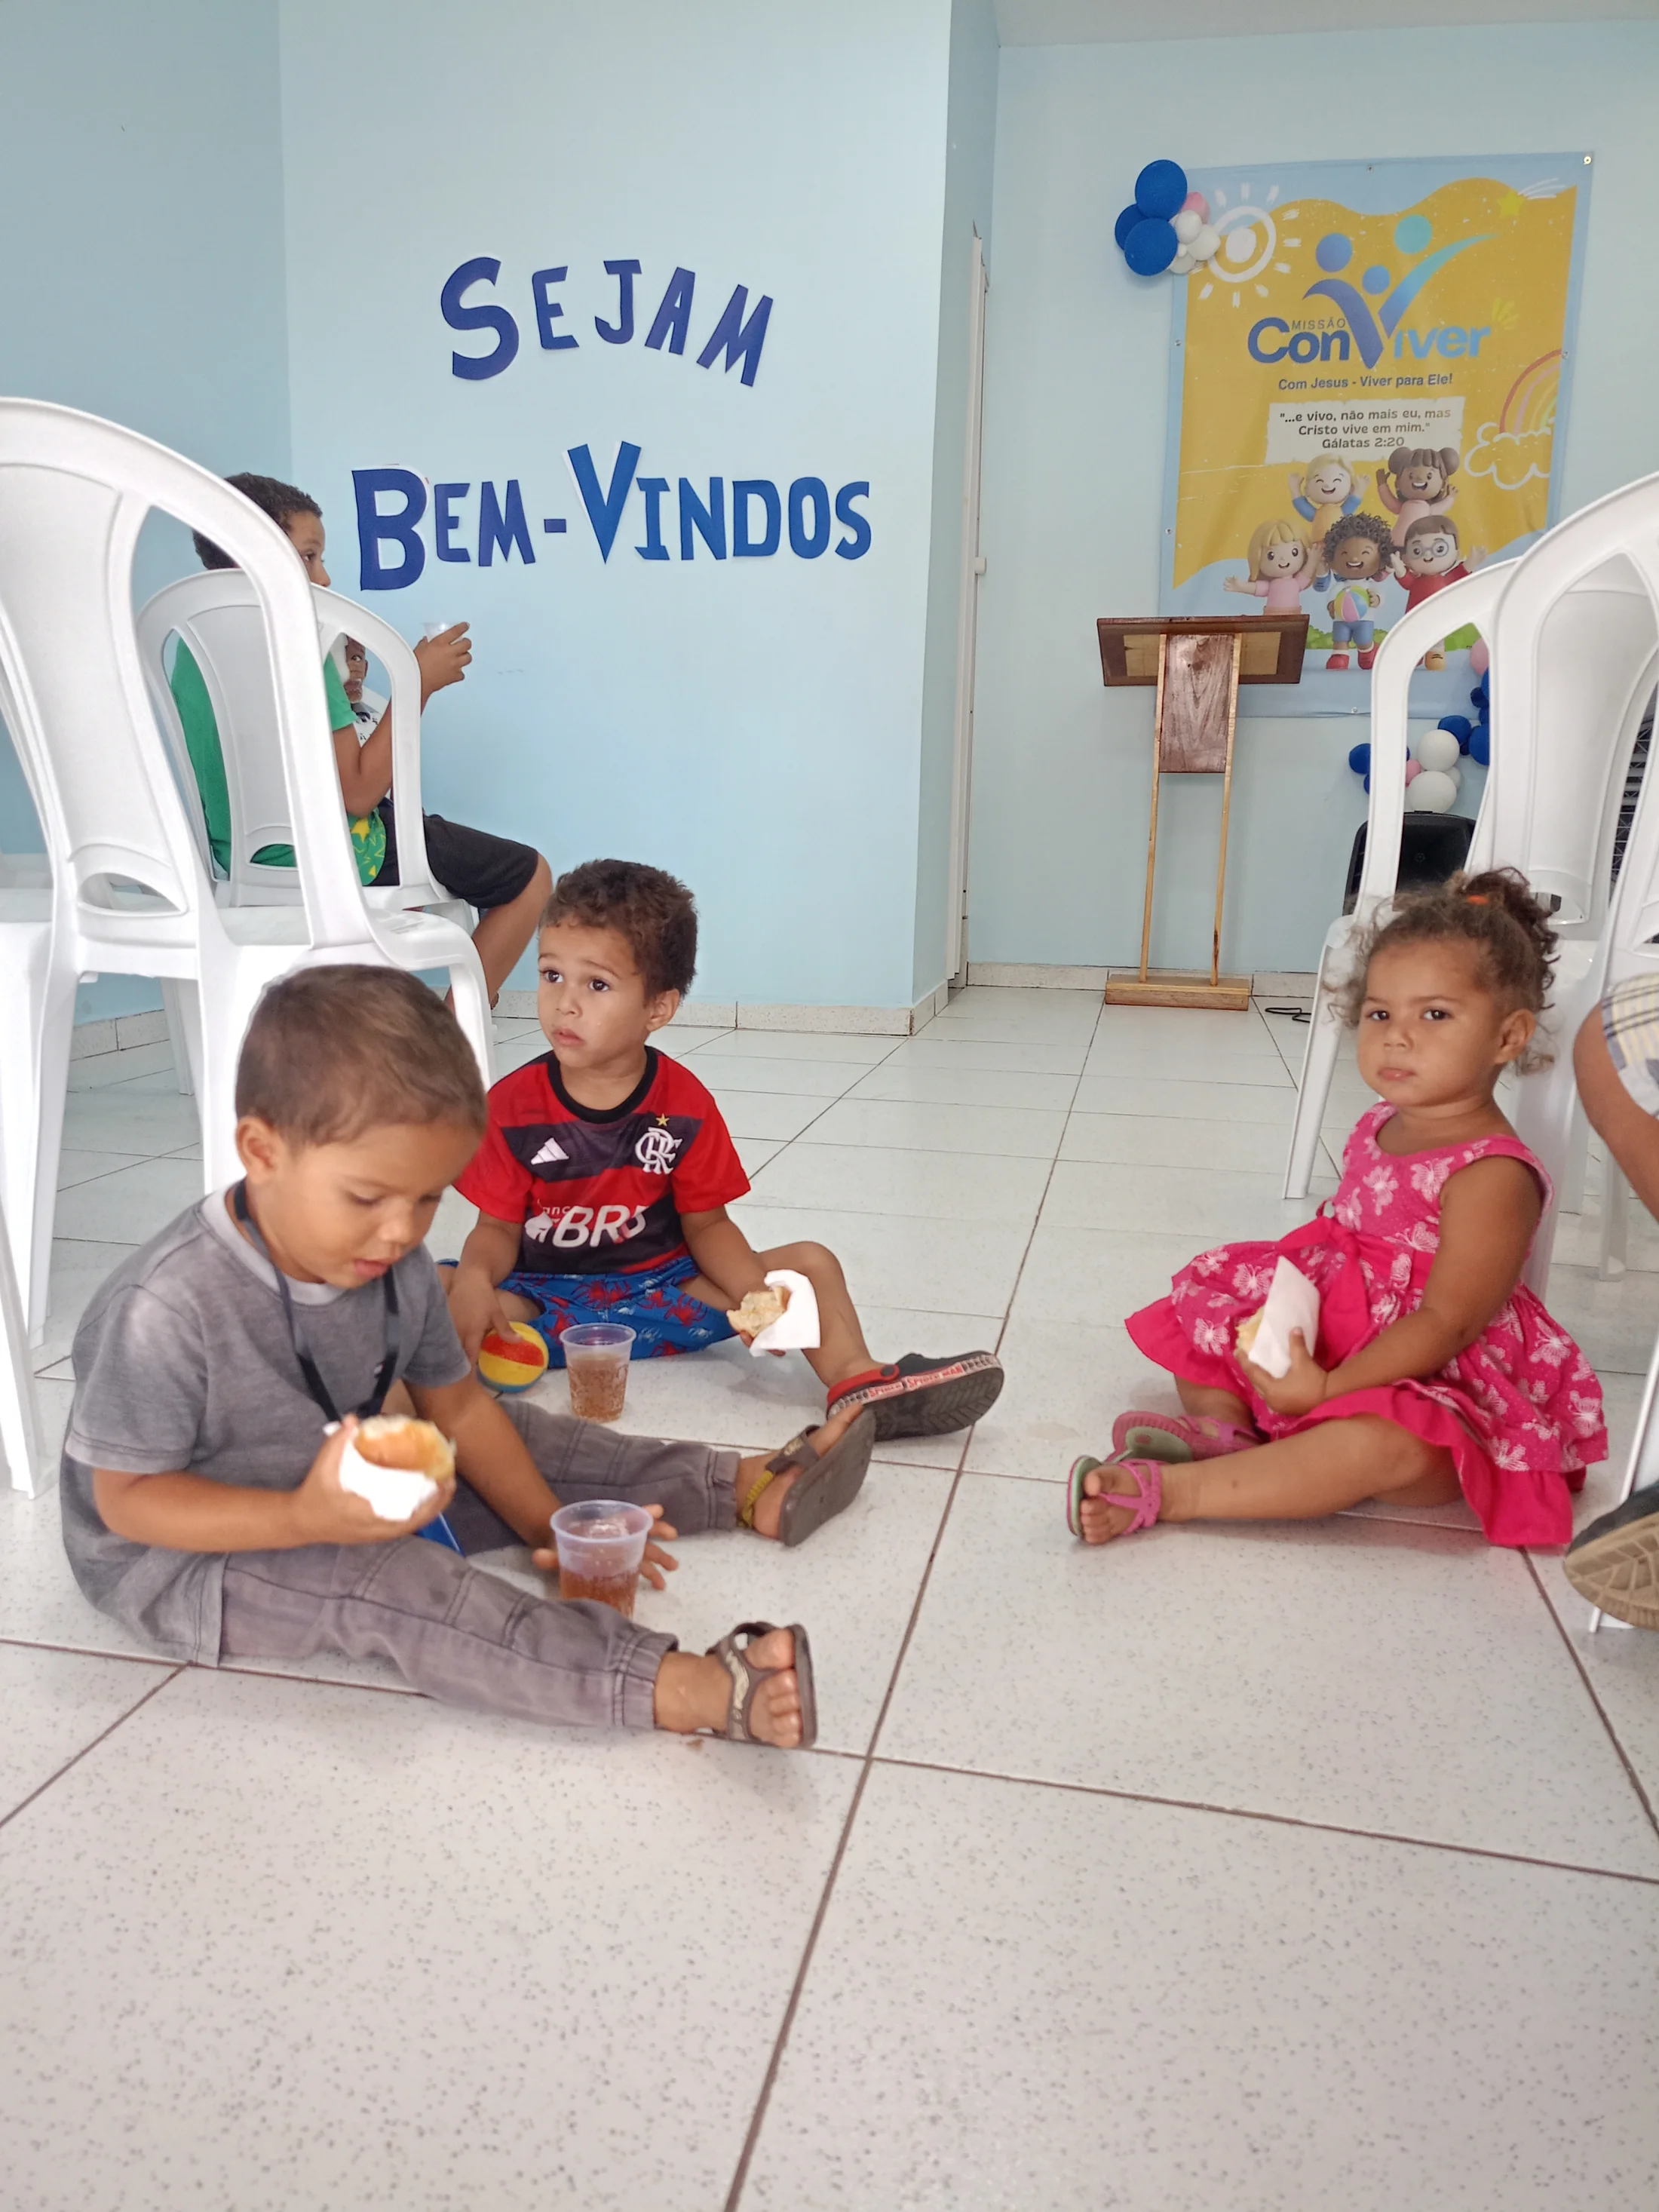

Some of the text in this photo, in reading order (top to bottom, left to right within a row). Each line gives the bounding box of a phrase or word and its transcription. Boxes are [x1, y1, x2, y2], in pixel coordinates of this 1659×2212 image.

[441, 256, 774, 387] SEJAM
[1291, 318, 1346, 330] MISSÃO
[1278, 378, 1308, 390] Com
[1311, 376, 1348, 389] Jesus
[1360, 375, 1392, 387] Viver
[1396, 376, 1424, 388] para
[1427, 373, 1453, 385] Ele!
[1307, 411, 1337, 422] vivo,
[1341, 410, 1364, 421] não
[1368, 409, 1398, 420] mais
[1402, 410, 1421, 419] eu,
[1424, 409, 1451, 419] mas
[1299, 422, 1431, 435] Cristo vive em mim."
[1322, 437, 1405, 449] Gálatas 2:20
[351, 441, 872, 591] BEM-VINDOS
